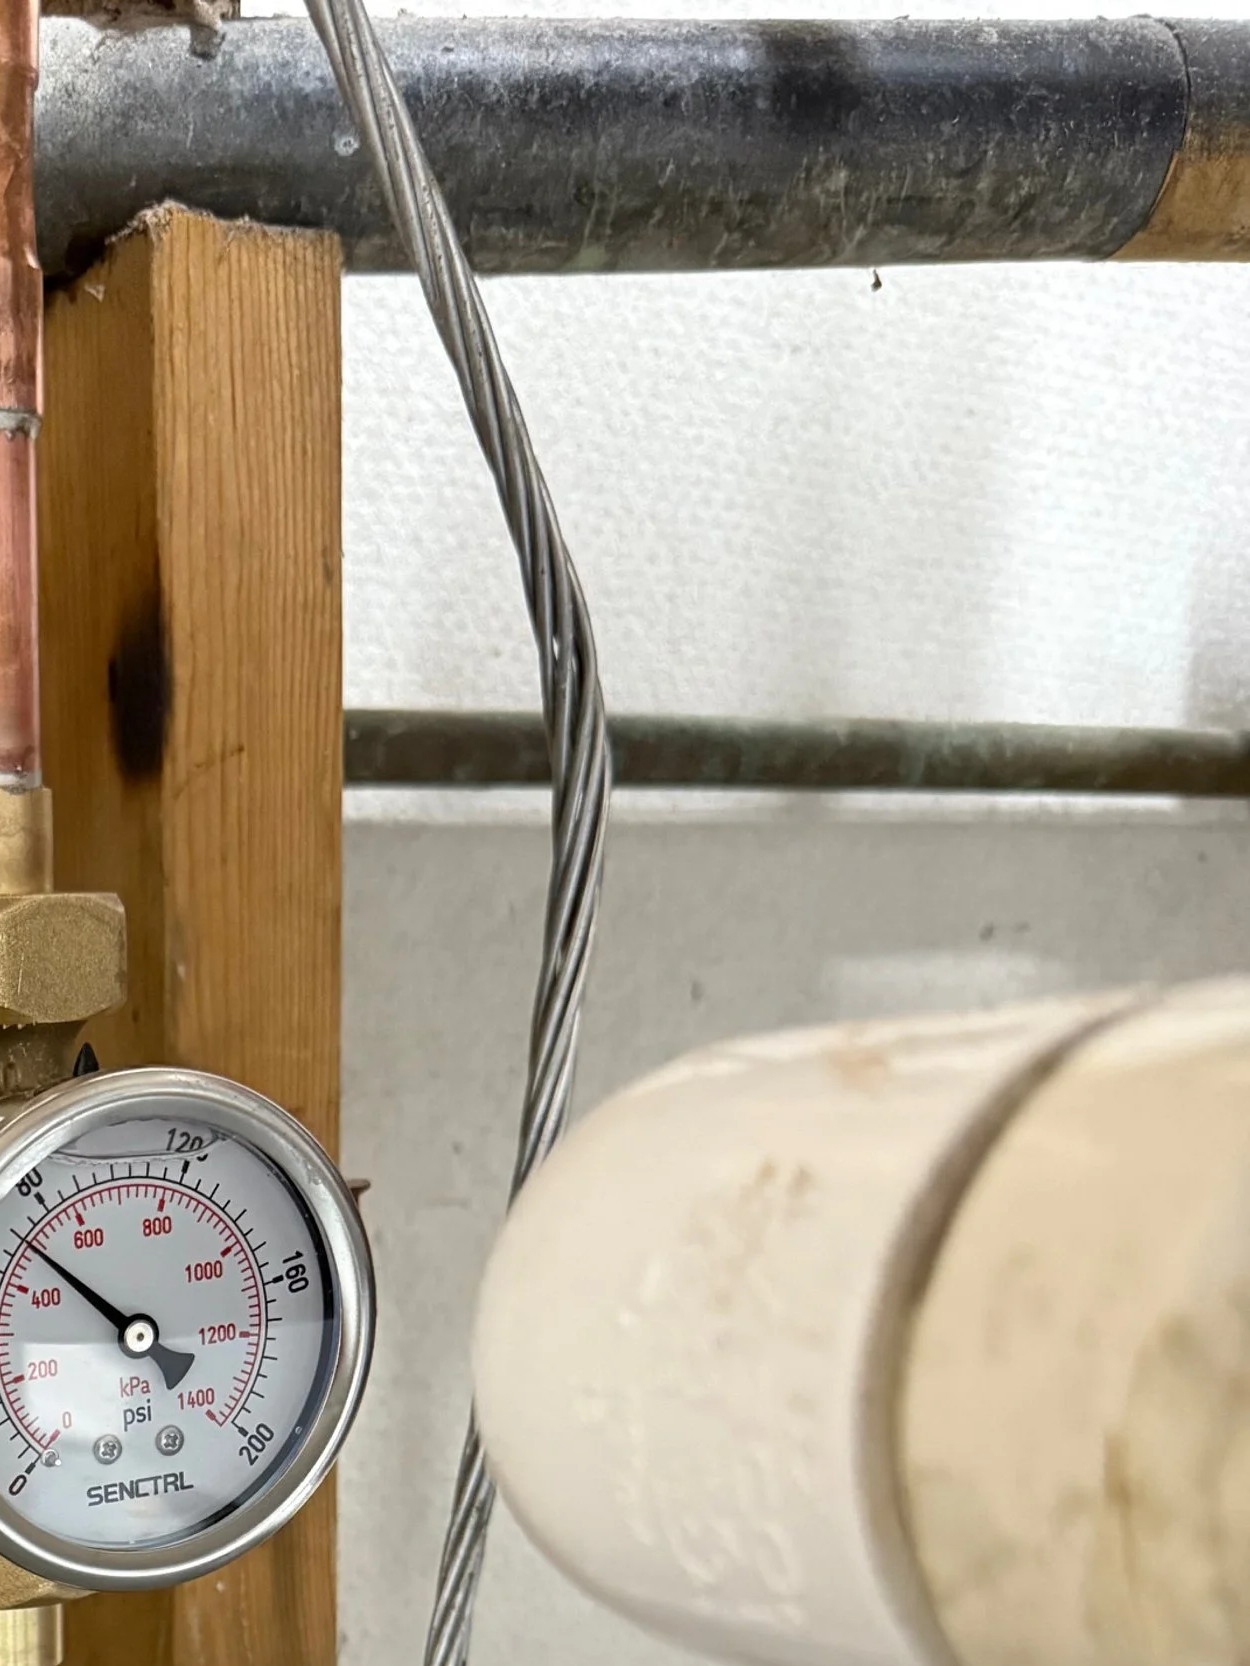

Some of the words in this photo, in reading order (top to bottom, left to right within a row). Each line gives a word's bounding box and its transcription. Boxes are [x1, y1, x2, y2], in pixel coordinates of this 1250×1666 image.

[142, 1216, 172, 1237] 800
[74, 1228, 104, 1249] 600
[184, 1260, 223, 1282] 1000
[281, 1251, 309, 1293] 160
[31, 1288, 61, 1308] 400
[198, 1324, 236, 1346] 1200
[28, 1360, 58, 1380] 200
[119, 1377, 150, 1399] kPa
[177, 1389, 215, 1411] 1400
[62, 1411, 72, 1429] 0
[123, 1398, 152, 1431] psi
[238, 1423, 275, 1466] 200
[8, 1474, 27, 1495] 0
[86, 1472, 194, 1506] SENCTRL
